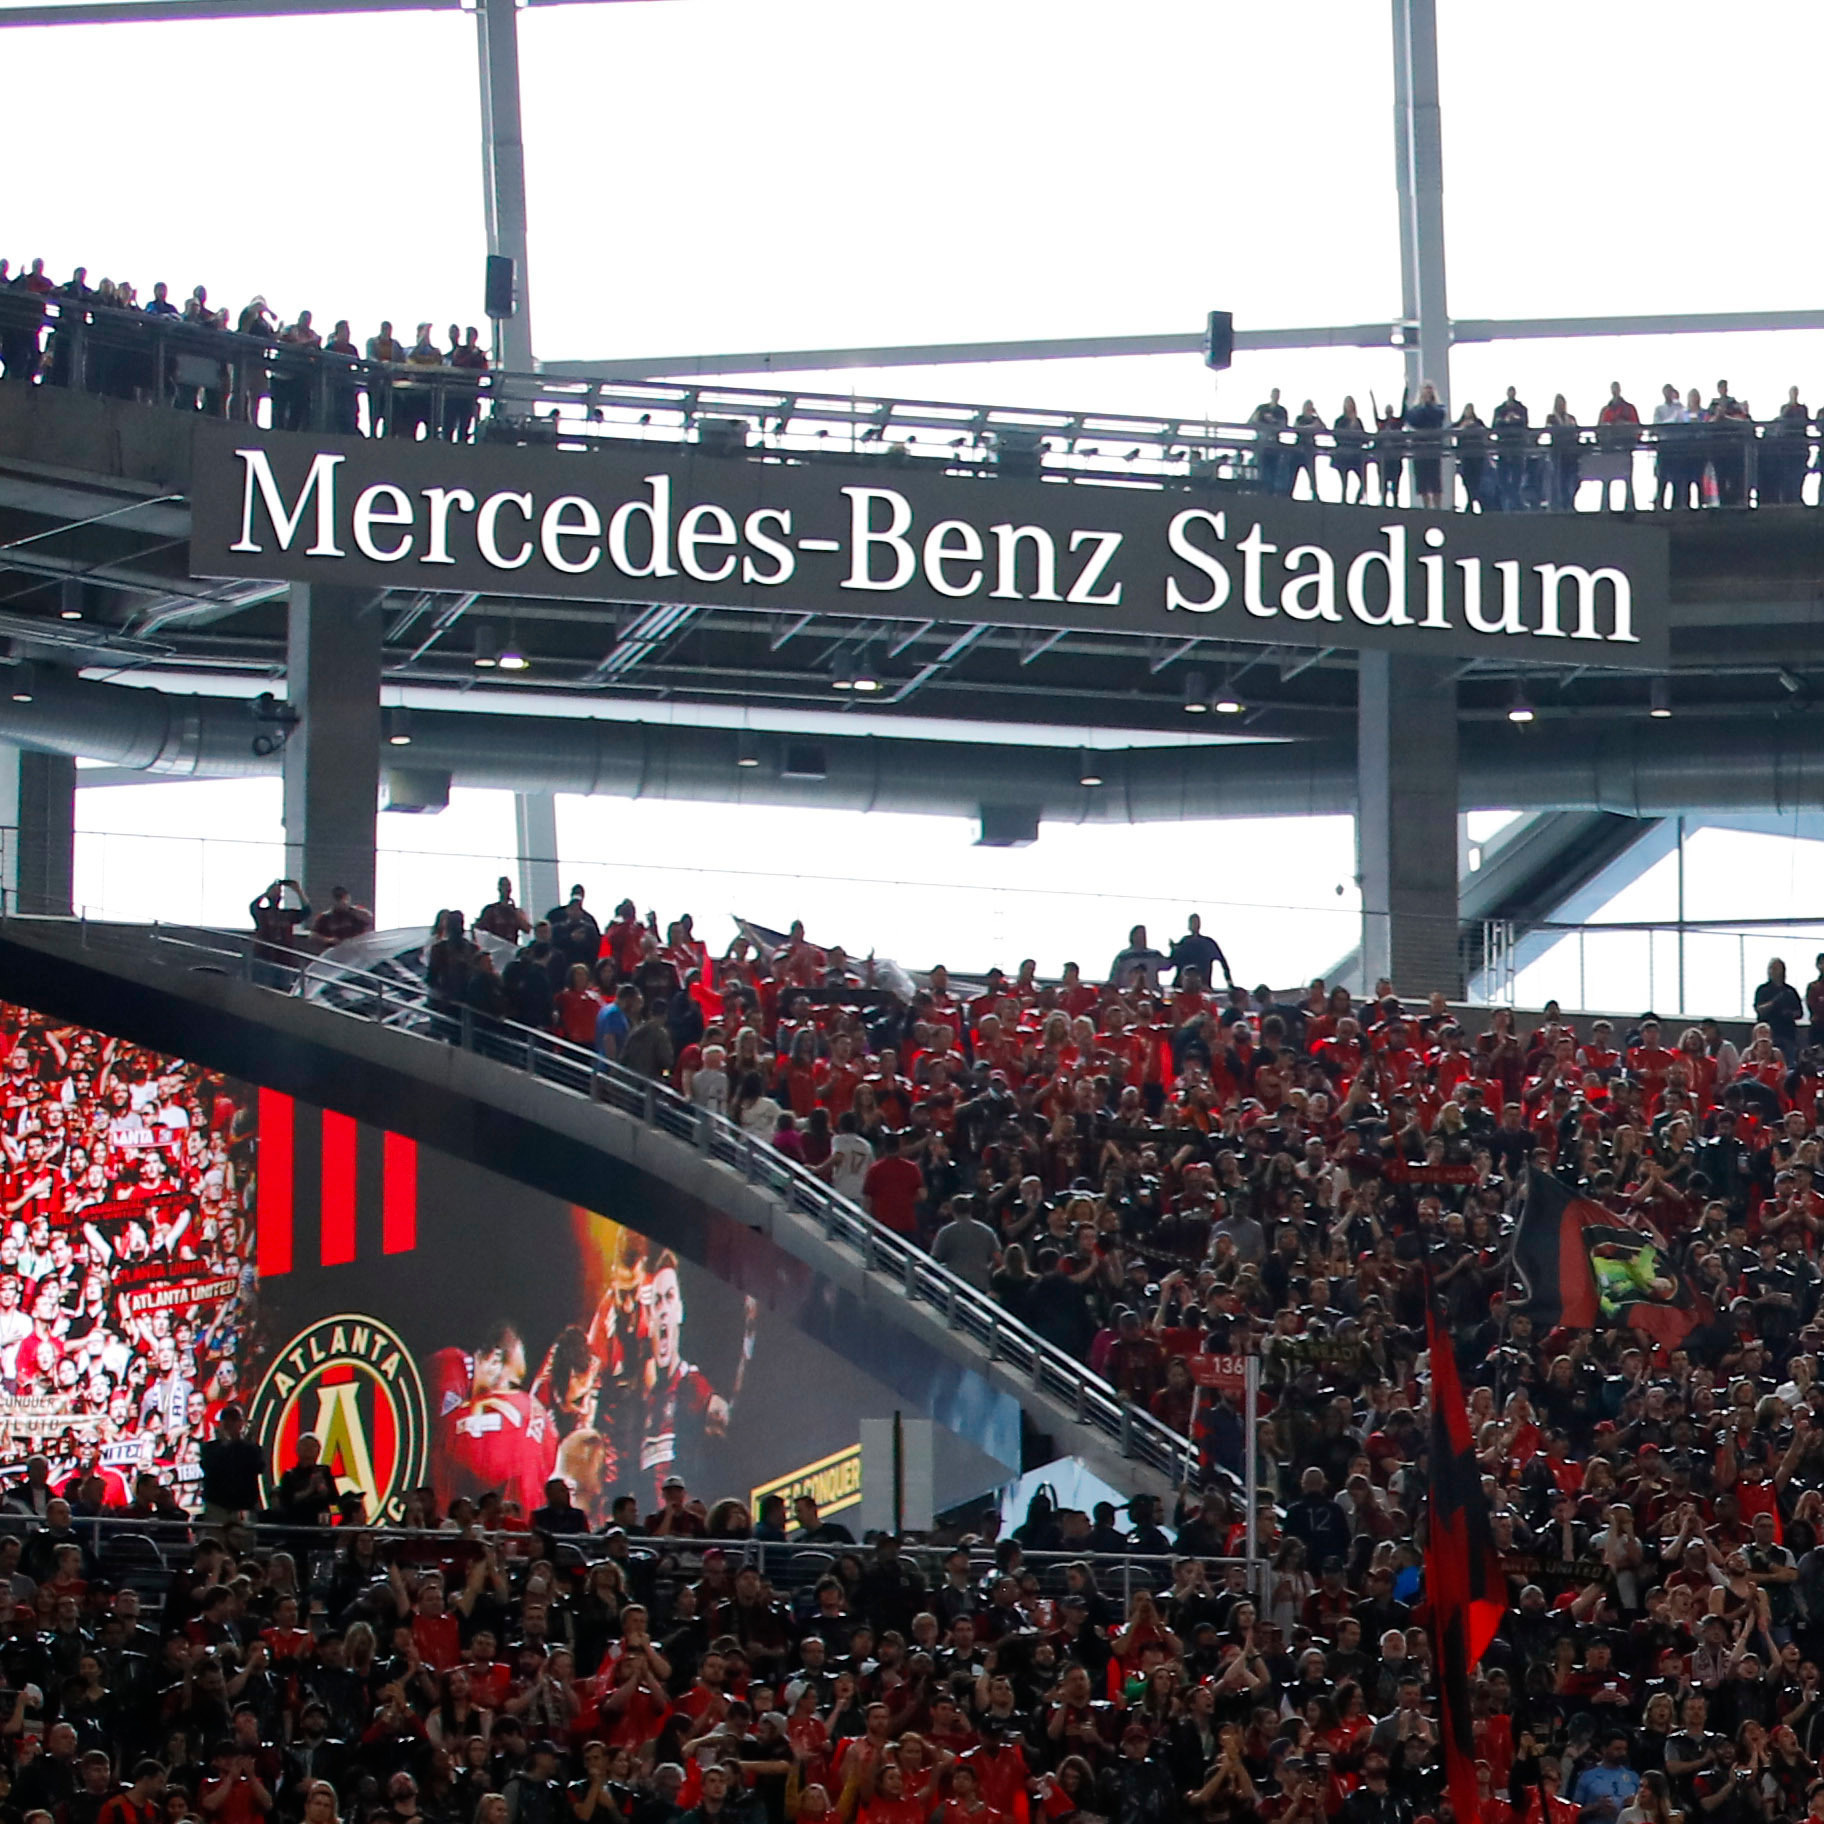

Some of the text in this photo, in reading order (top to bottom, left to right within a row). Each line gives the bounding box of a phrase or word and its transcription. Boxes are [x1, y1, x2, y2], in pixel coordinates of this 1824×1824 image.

[228, 447, 1642, 642] Mercedes-Benz Stadium
[131, 1278, 237, 1313] ATLANTA UNITED
[273, 1326, 401, 1397] ATLANTA
[1213, 1357, 1245, 1375] 136
